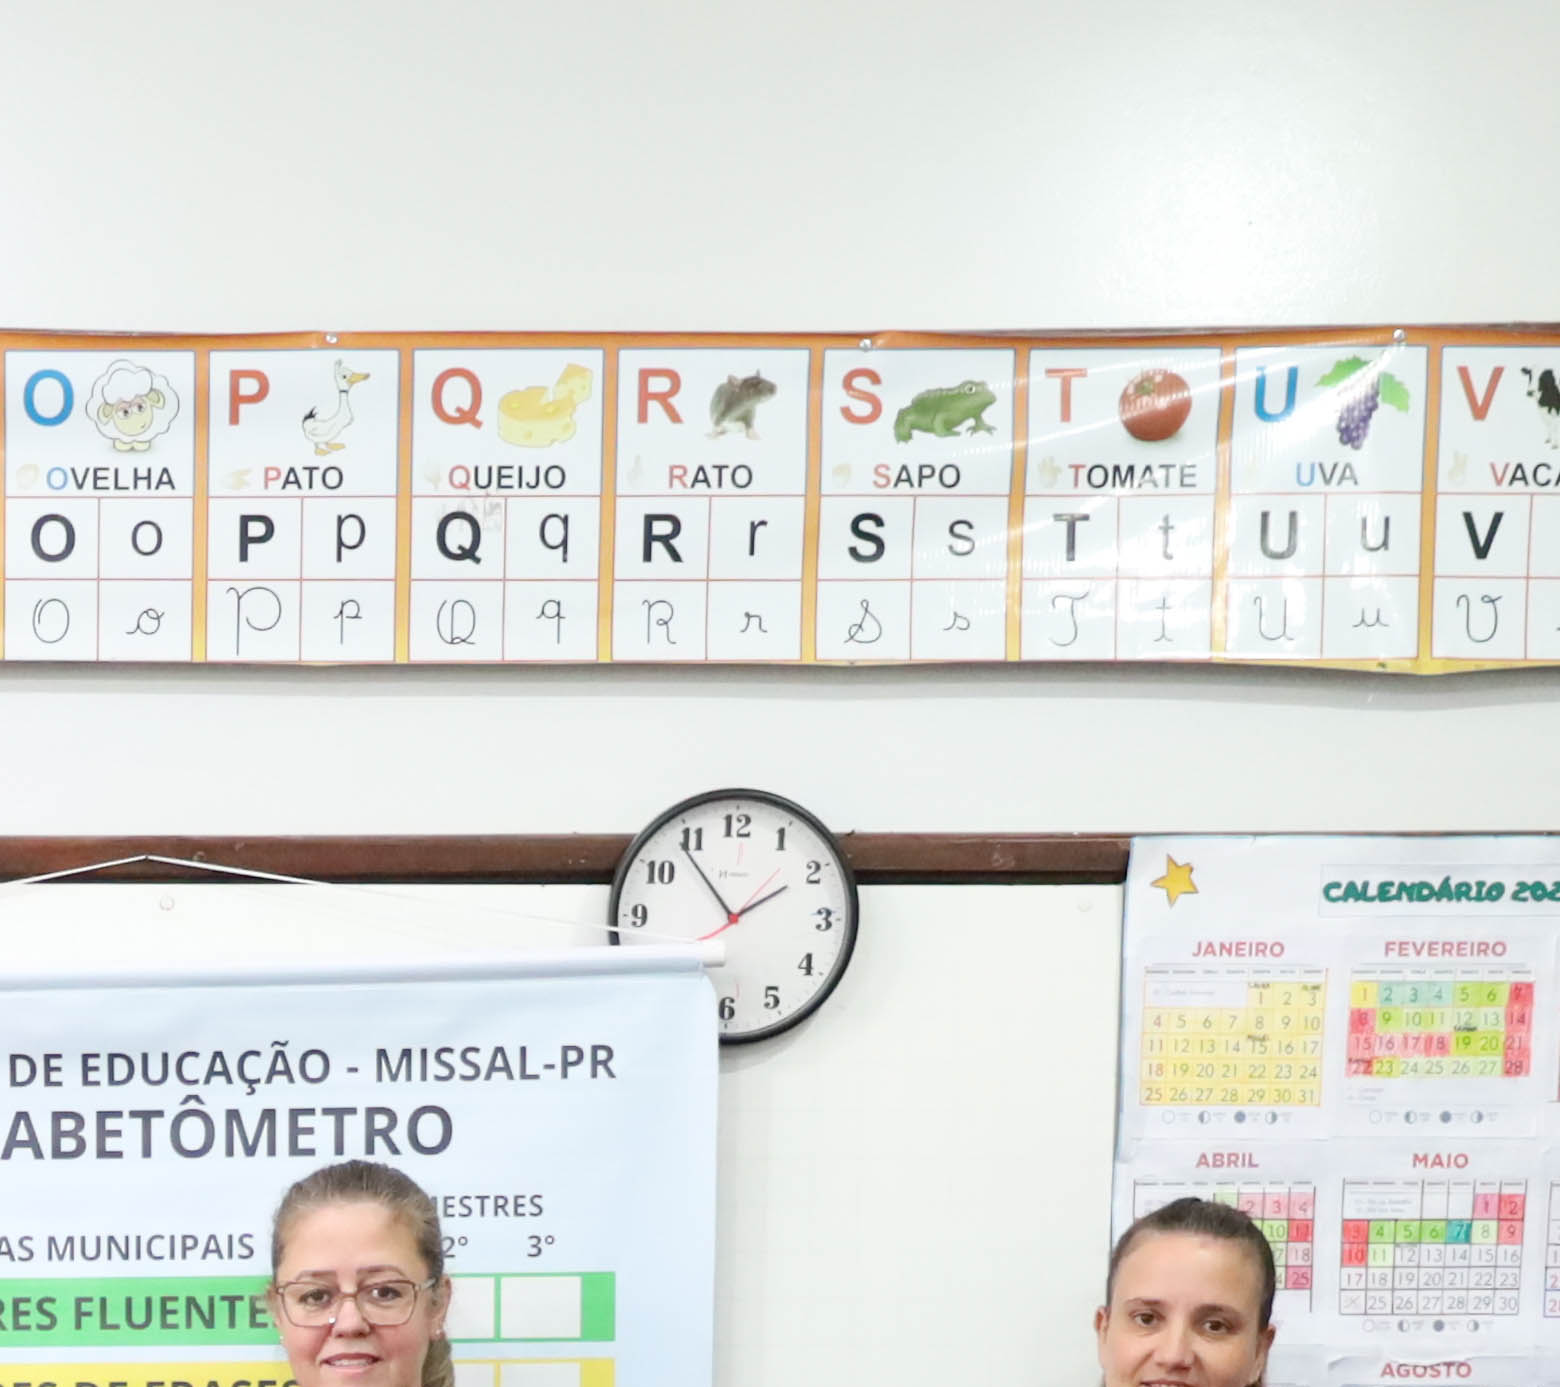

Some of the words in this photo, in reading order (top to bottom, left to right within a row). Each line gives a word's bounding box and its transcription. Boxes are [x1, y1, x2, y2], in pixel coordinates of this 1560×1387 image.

[22, 368, 75, 428] O
[45, 464, 176, 492] OVELHA
[262, 464, 345, 491] PATO
[446, 463, 567, 492] QUEIJO
[668, 464, 754, 489] RATO
[872, 463, 961, 491] SAPO
[1067, 463, 1198, 490] TOMATE
[1295, 462, 1359, 488] UVA
[723, 814, 751, 838] 12
[646, 860, 675, 884] 10
[1323, 879, 1505, 904] CALENDÁRIO
[1384, 940, 1507, 958] FEVEREIRO
[719, 997, 735, 1020] 6
[764, 986, 780, 1009] 5
[9, 1052, 64, 1088] DE
[81, 1040, 332, 1097] EDUCAÇÃO
[374, 1044, 615, 1083] MISSAL-PR
[47, 1231, 254, 1263] MUNICIPAIS
[74, 1295, 277, 1331] FLUENTE
[1380, 1361, 1472, 1379] AGOSTO
